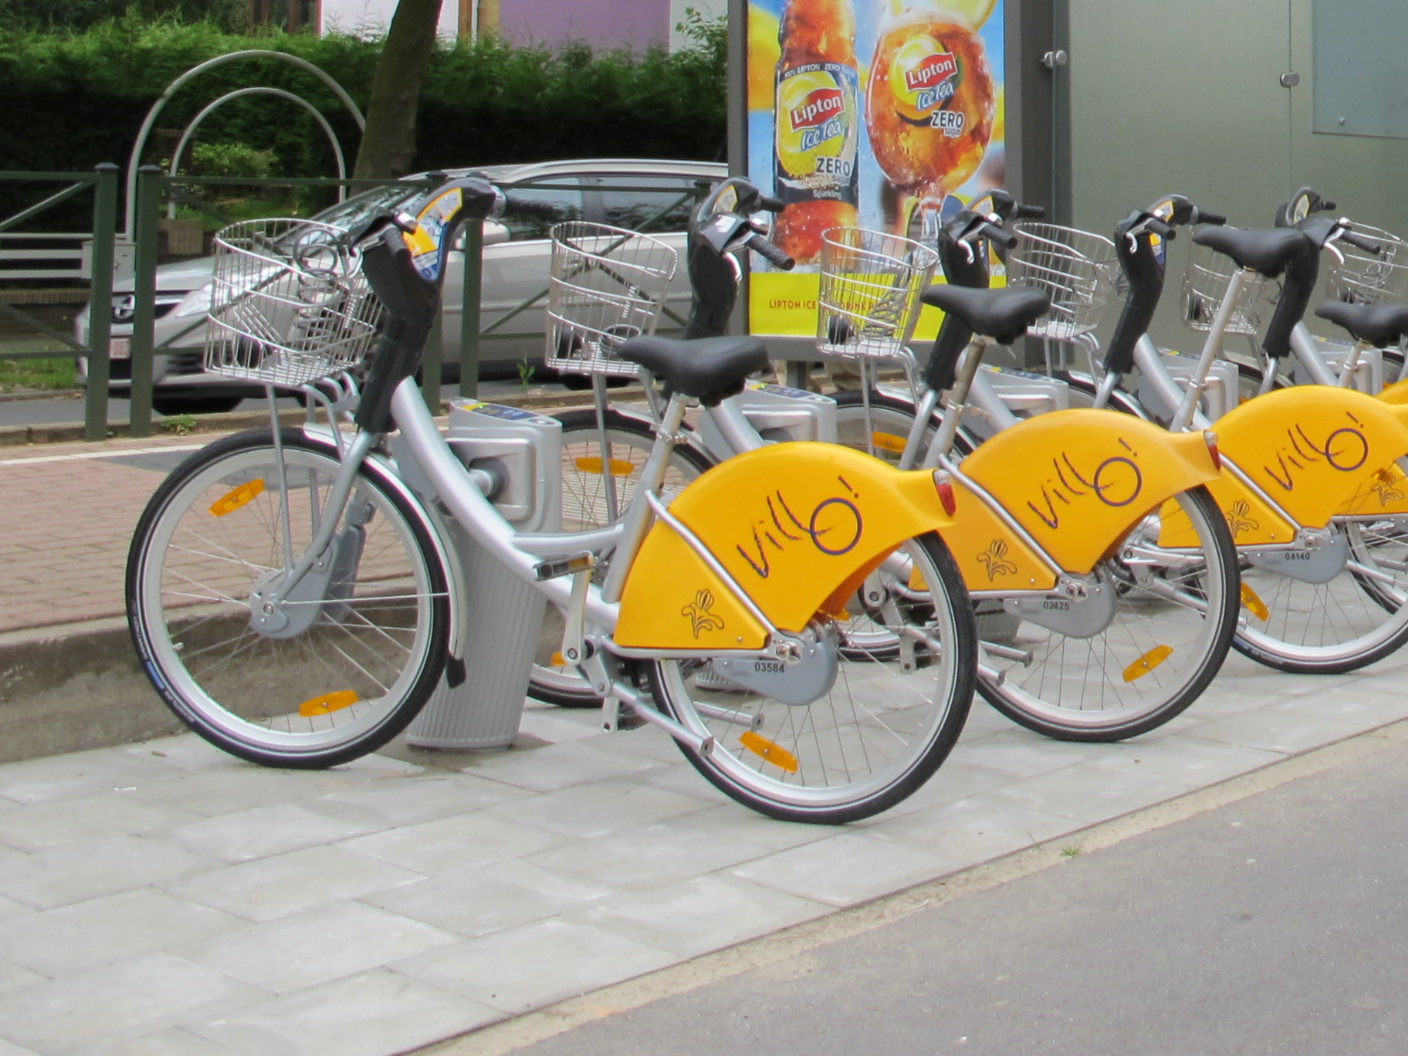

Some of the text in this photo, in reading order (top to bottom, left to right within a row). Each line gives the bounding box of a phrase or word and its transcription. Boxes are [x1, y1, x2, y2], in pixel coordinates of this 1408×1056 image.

[907, 58, 953, 87] Lipton
[917, 82, 954, 111] Ice Tea
[792, 94, 842, 125] Lipton
[931, 111, 965, 128] ZERO
[801, 119, 843, 152] Ice Tea
[816, 157, 850, 175] ZERO
[769, 299, 801, 310] LIPTON
[803, 299, 816, 310] ICE
[1284, 552, 1310, 560] 04140
[1043, 600, 1070, 611] 02425
[754, 662, 785, 674] 03584
